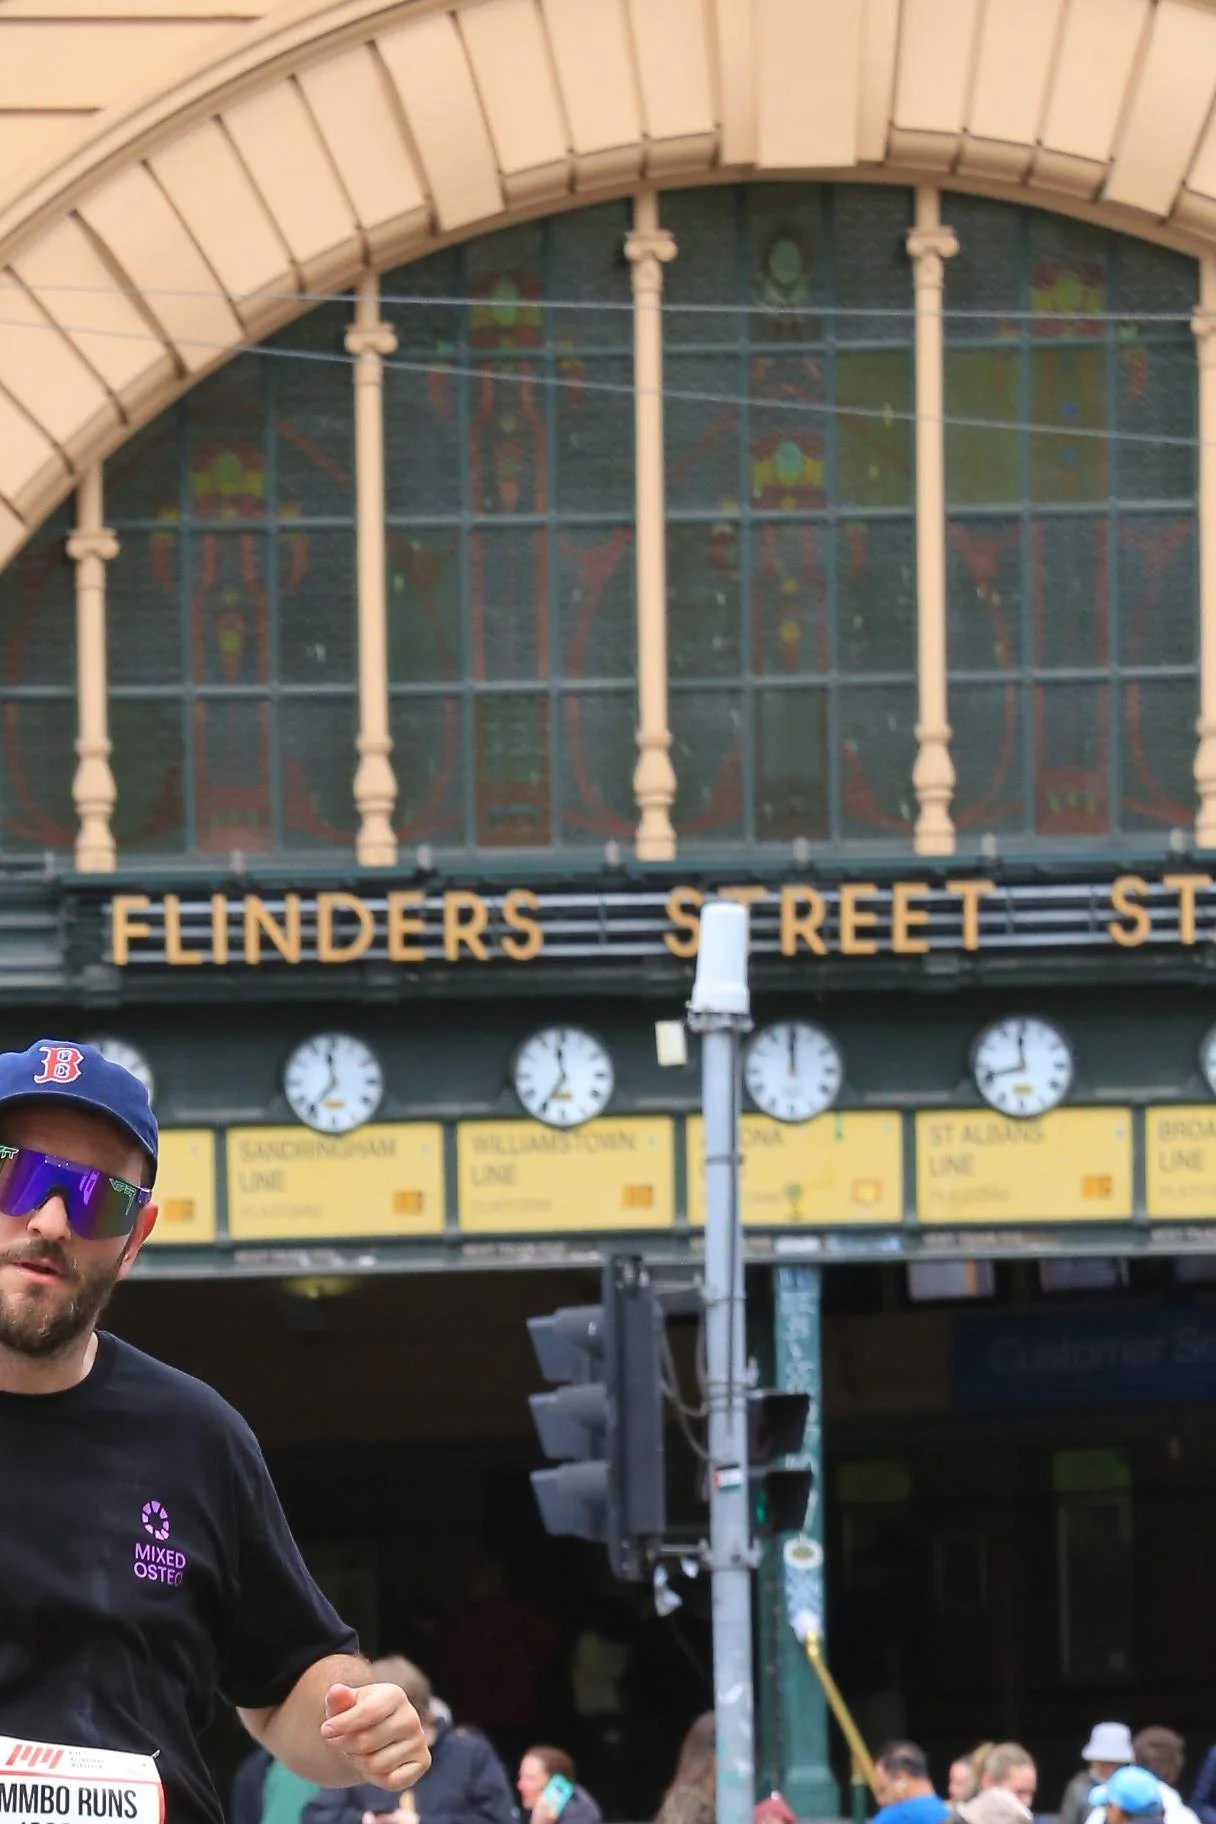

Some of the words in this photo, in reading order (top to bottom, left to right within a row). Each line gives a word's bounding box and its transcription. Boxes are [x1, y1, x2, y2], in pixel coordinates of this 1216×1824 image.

[111, 889, 543, 965] FLINDERS
[34, 1047, 84, 1084] B
[470, 1131, 637, 1156] WILLIAMSTOWN
[929, 1123, 954, 1146] ST
[962, 1121, 1044, 1145] ALBANS
[929, 1153, 975, 1177] LINE
[1158, 1150, 1204, 1173] LINE
[238, 1171, 286, 1194] LINE
[470, 1164, 517, 1188] LINE
[135, 1543, 186, 1569] MIXED
[78, 1787, 137, 1818] RUNS
